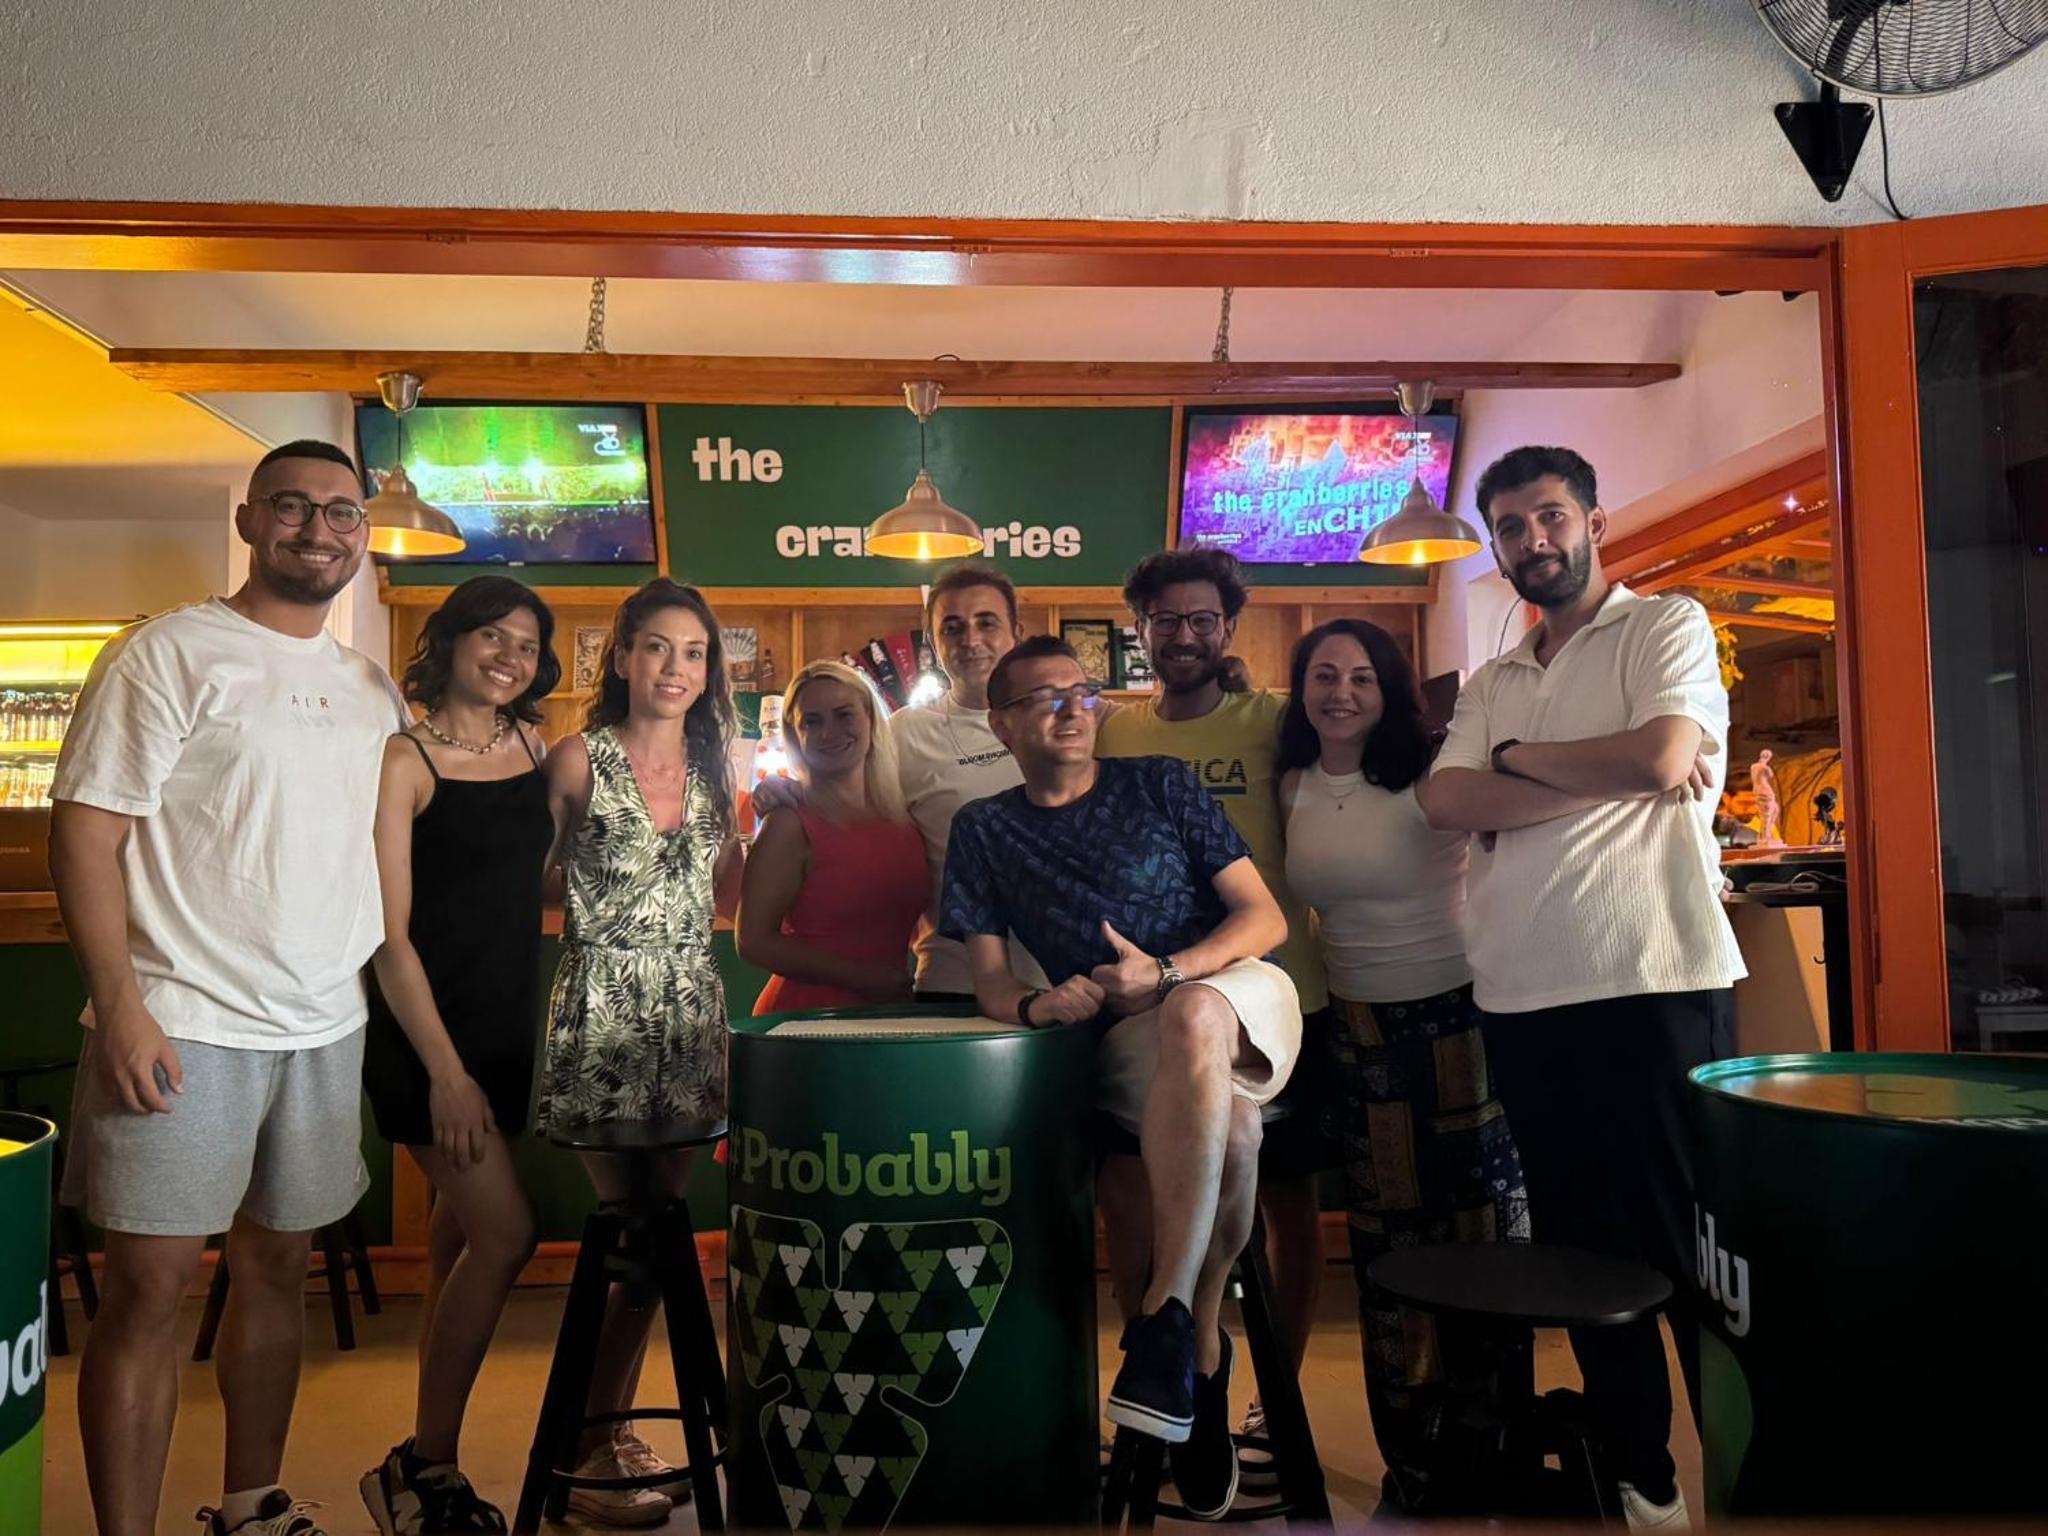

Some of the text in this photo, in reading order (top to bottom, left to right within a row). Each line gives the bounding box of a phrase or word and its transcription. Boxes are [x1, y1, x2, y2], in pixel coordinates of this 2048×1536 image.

[691, 436, 784, 483] the
[1212, 489, 1252, 514] the
[775, 521, 1082, 558] craries
[1295, 519, 1323, 536] EN
[291, 693, 330, 709] AIR
